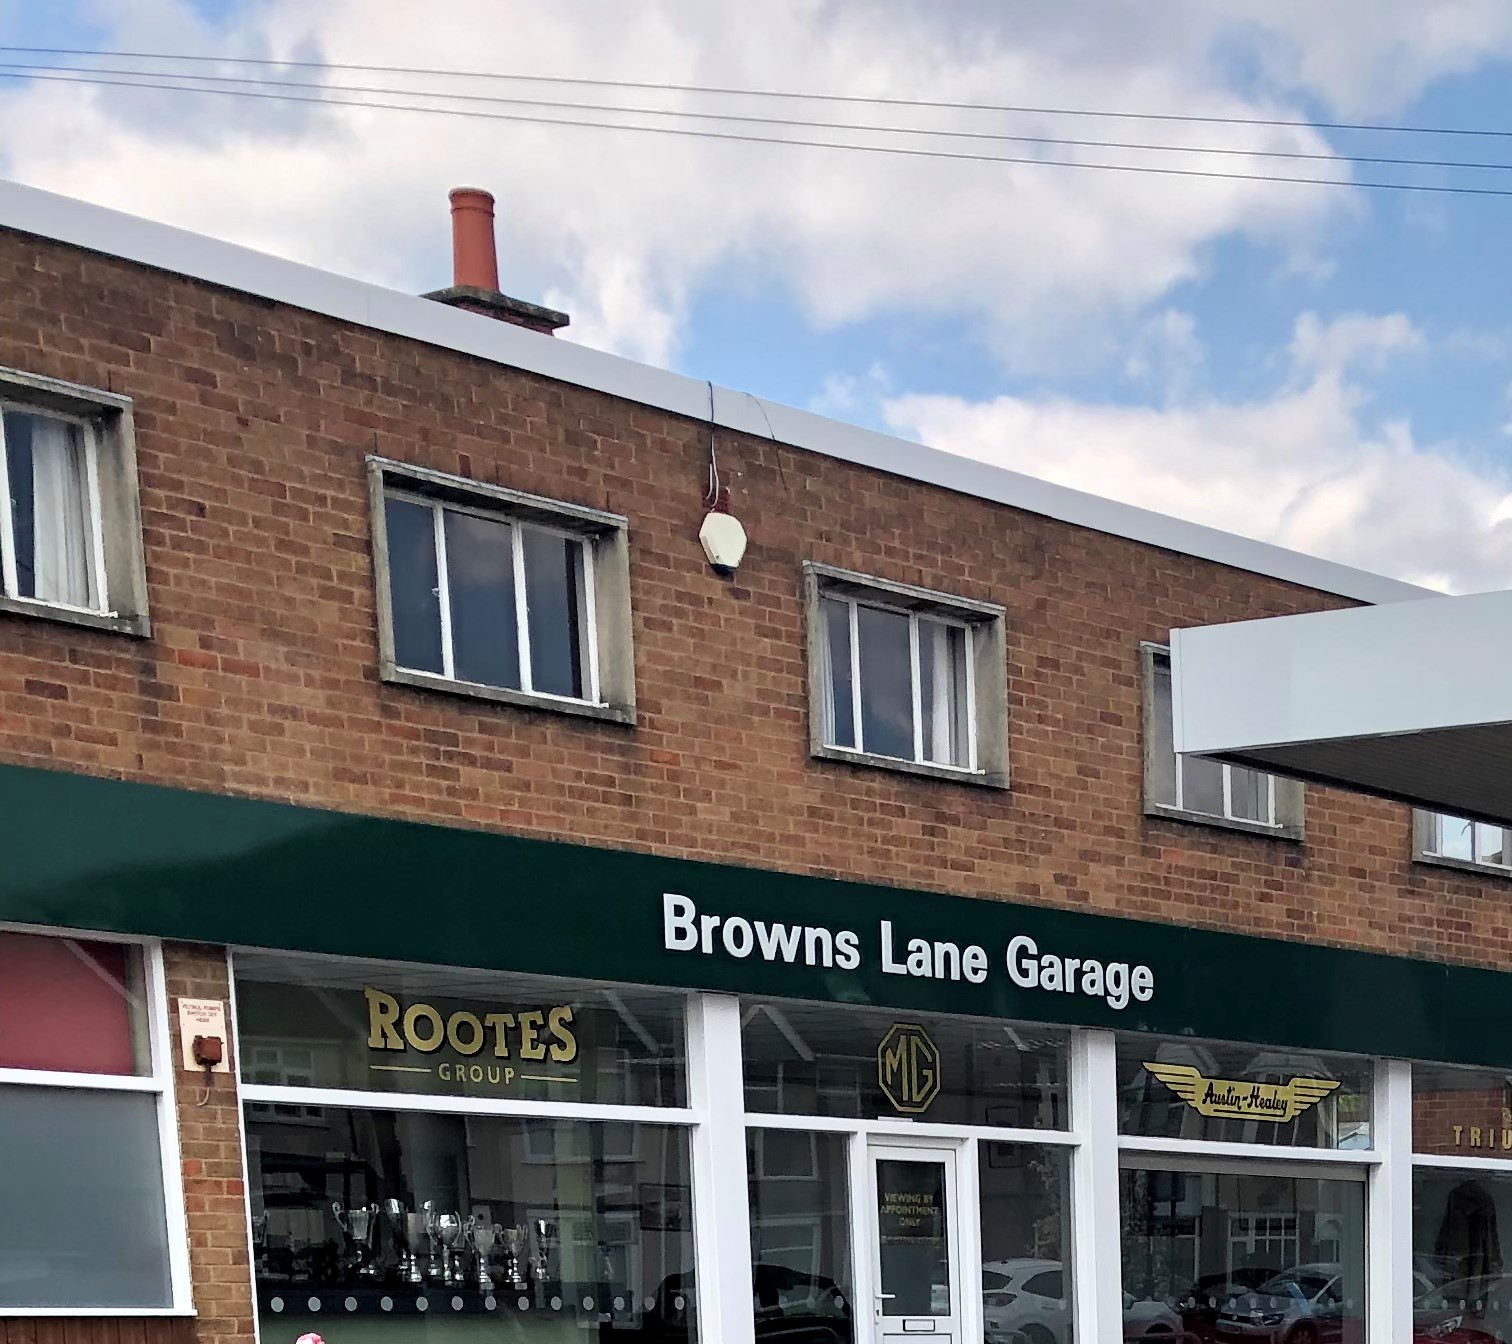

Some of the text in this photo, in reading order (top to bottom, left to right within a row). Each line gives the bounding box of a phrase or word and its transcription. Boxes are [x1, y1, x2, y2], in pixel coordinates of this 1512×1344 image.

[663, 893, 1154, 1010] Browns Lane Garage
[364, 985, 578, 1063] ROOTES
[438, 1063, 515, 1084] GROUP
[885, 1035, 933, 1102] MG
[1202, 1082, 1288, 1117] Austin-Healey
[885, 1193, 920, 1203] VIEWING
